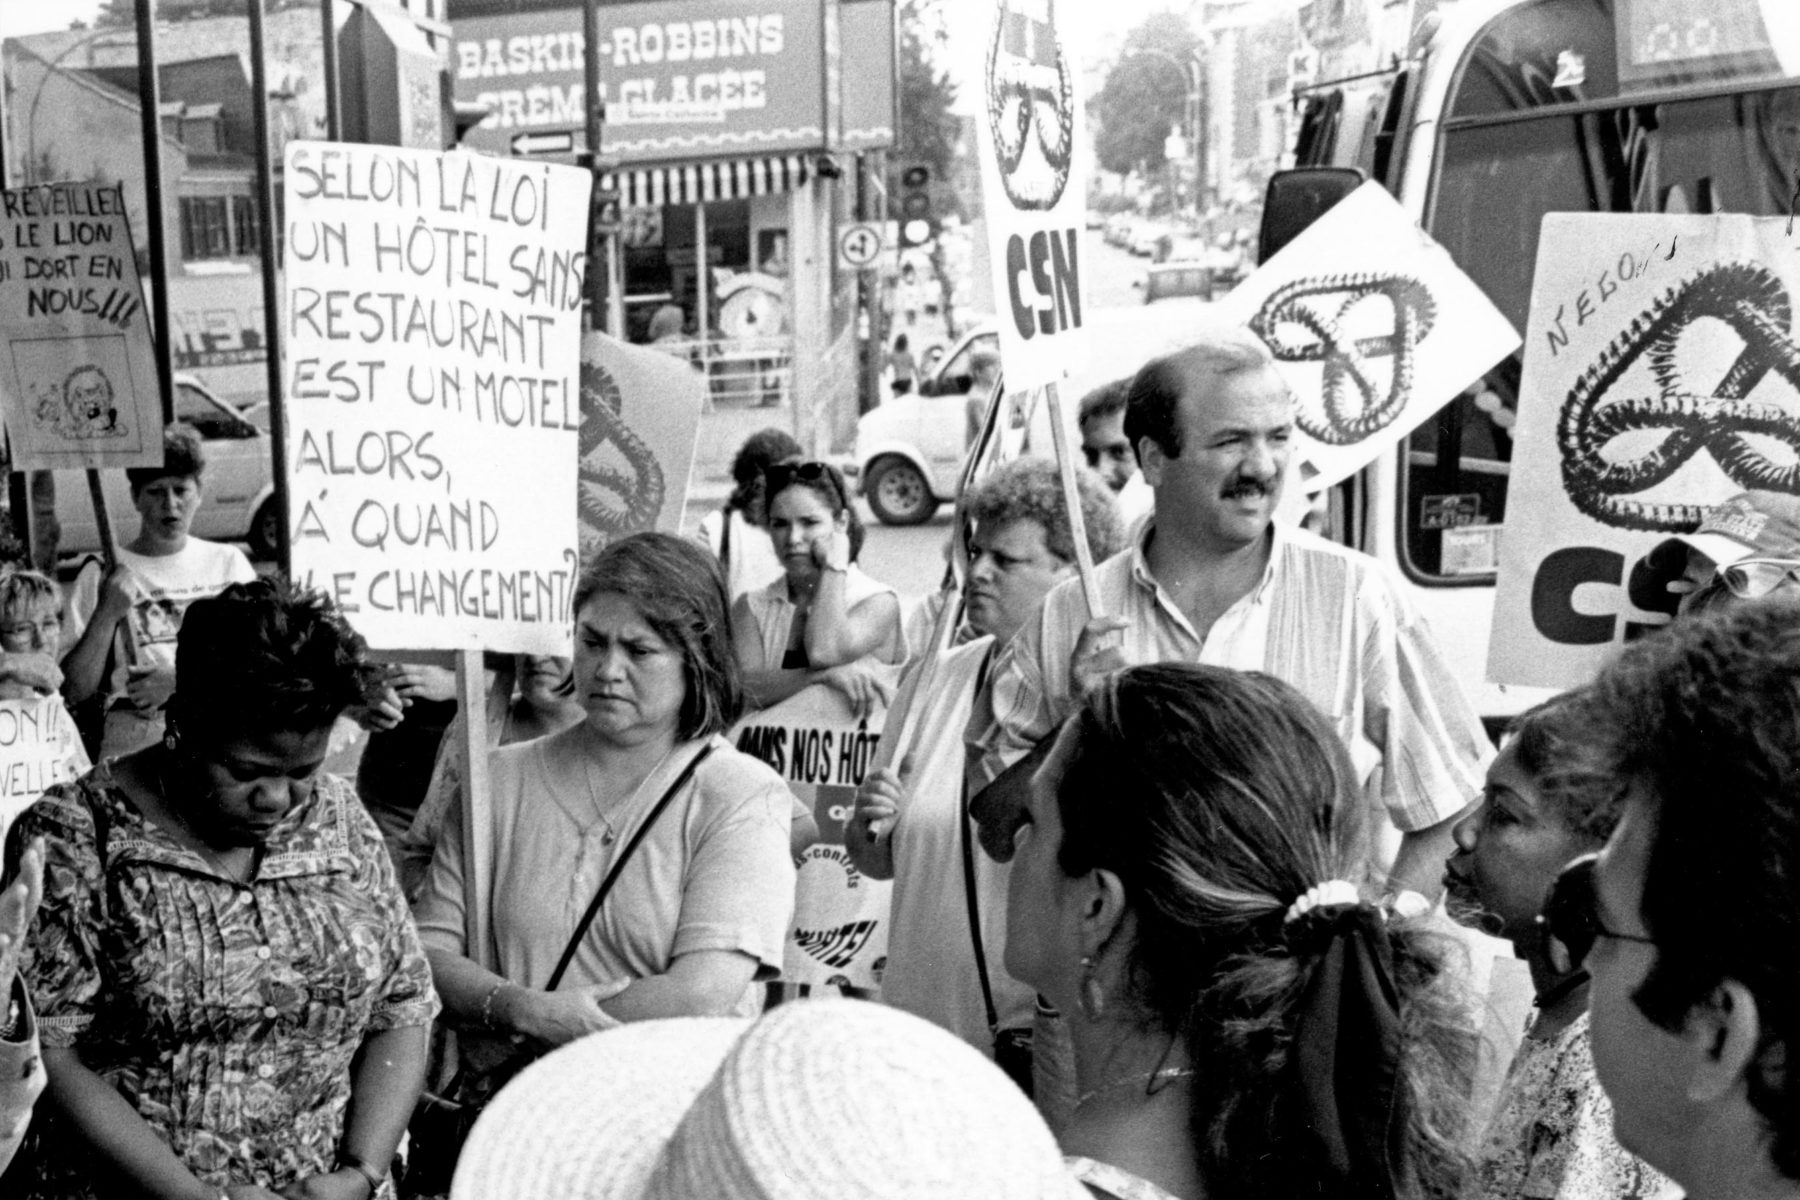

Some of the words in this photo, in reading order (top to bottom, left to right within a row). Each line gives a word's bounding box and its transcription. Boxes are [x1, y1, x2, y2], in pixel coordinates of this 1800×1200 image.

[291, 151, 422, 207] SELON
[436, 157, 478, 213] LA
[16, 222, 41, 248] LE
[53, 221, 113, 247] LION
[290, 221, 349, 269] UN
[374, 215, 500, 290] HÔTEL
[509, 244, 586, 312] SANS
[24, 255, 80, 282] DORT
[88, 254, 122, 280] EN
[1006, 227, 1082, 341] CSN
[27, 288, 140, 330] NOUS!!!
[291, 287, 555, 370] RESTAURANT
[291, 357, 386, 403] EST
[407, 365, 463, 413] UN
[475, 371, 579, 432] MOTEL
[295, 430, 451, 495] ALORS,
[351, 499, 499, 553] QUAND
[368, 547, 578, 640] CHANGEMENT?
[790, 728, 834, 785] NOS
